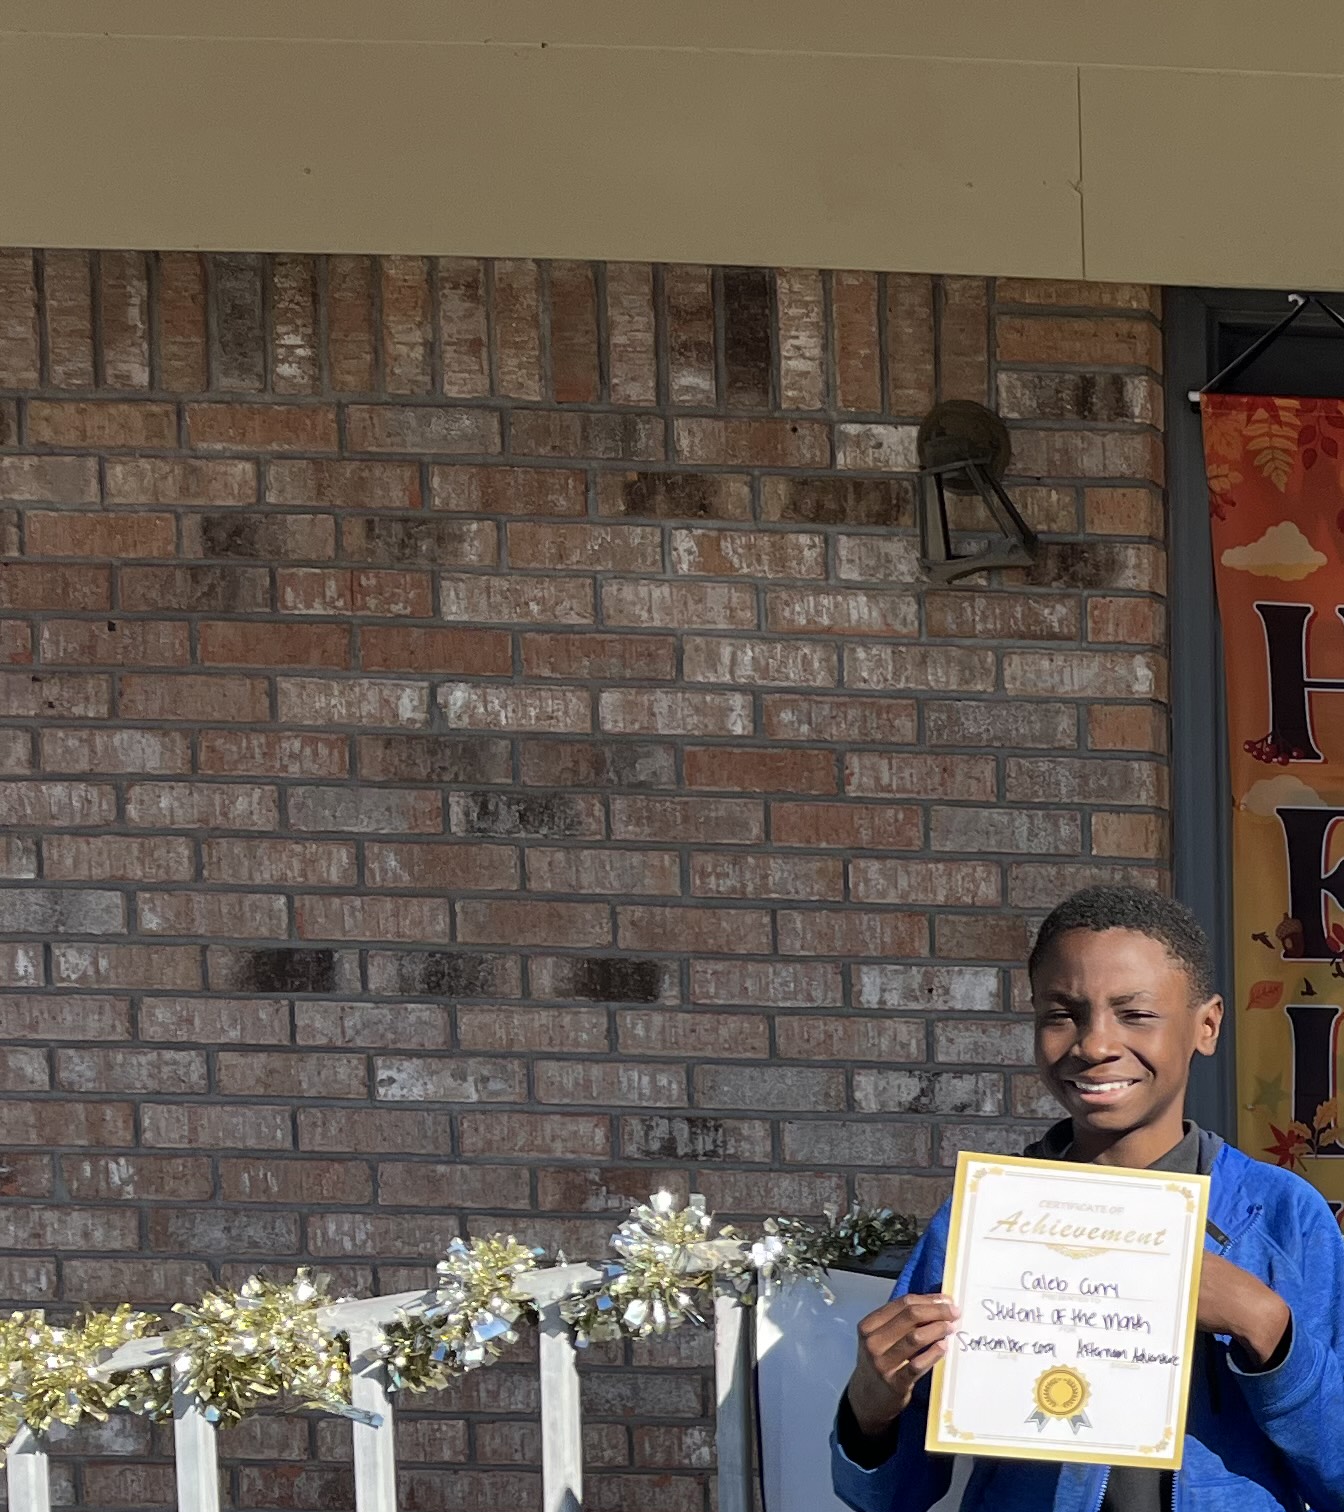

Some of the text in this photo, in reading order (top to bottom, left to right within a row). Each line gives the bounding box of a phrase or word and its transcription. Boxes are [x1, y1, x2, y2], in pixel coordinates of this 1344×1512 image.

[1039, 1200, 1107, 1214] CERTIFICATE
[989, 1210, 1167, 1246] Achievement
[1020, 1271, 1069, 1292] Caleb
[981, 1299, 1044, 1323] Student
[1070, 1308, 1097, 1327] the
